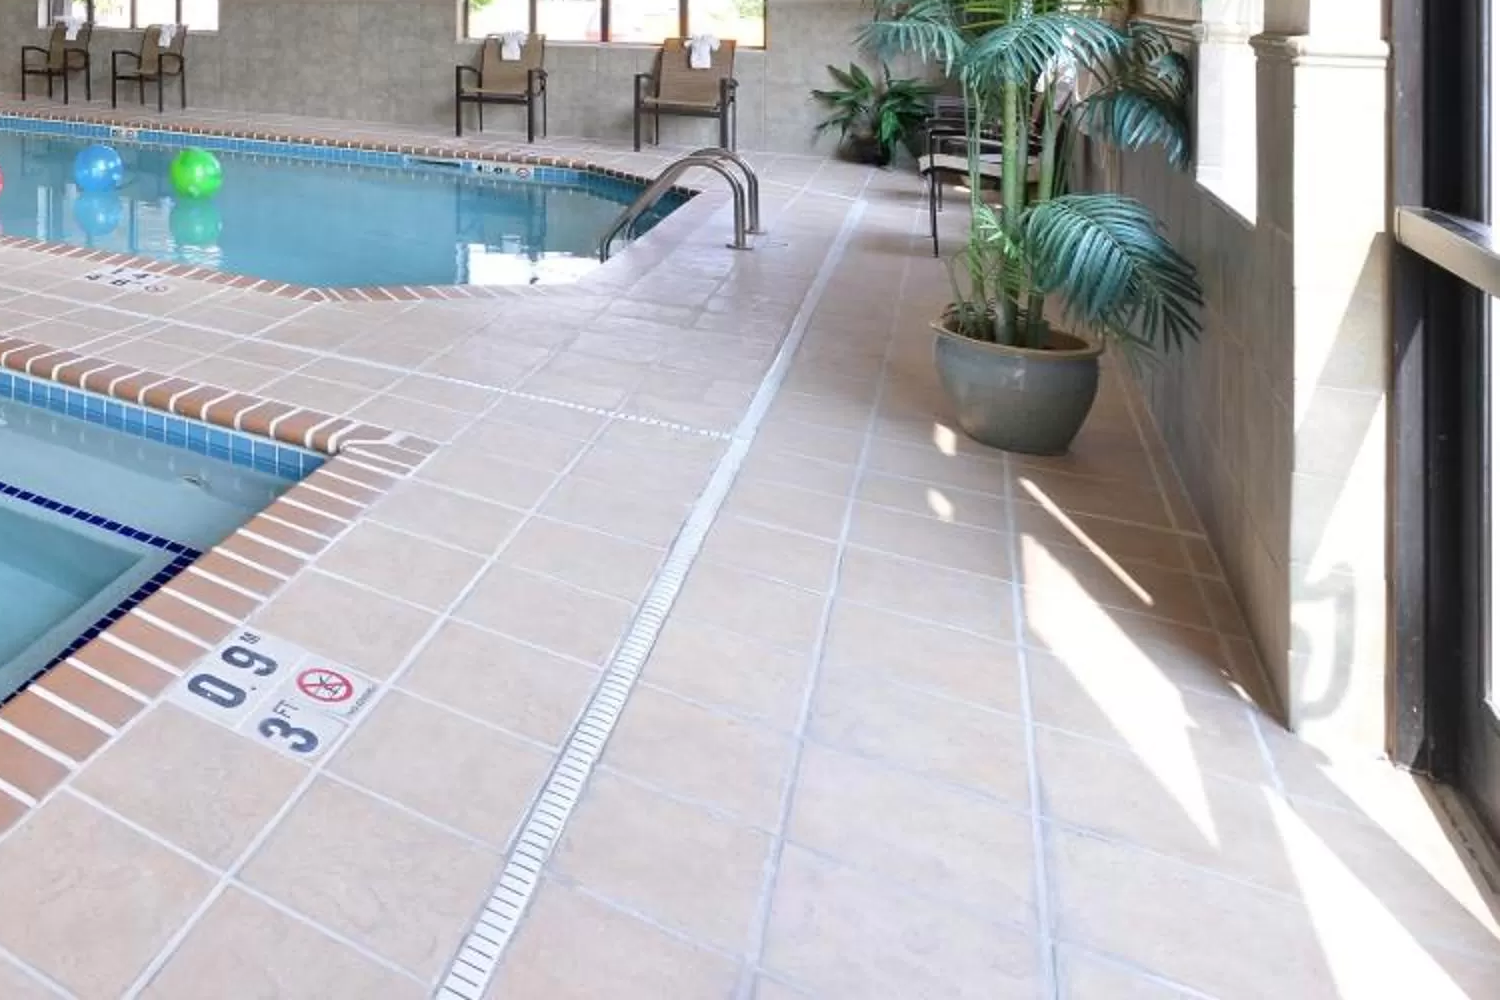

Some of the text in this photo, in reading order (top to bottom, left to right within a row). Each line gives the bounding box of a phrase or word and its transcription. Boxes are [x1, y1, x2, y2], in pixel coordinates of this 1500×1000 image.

[187, 645, 278, 709] 0.9
[258, 699, 319, 753] 3 FT
